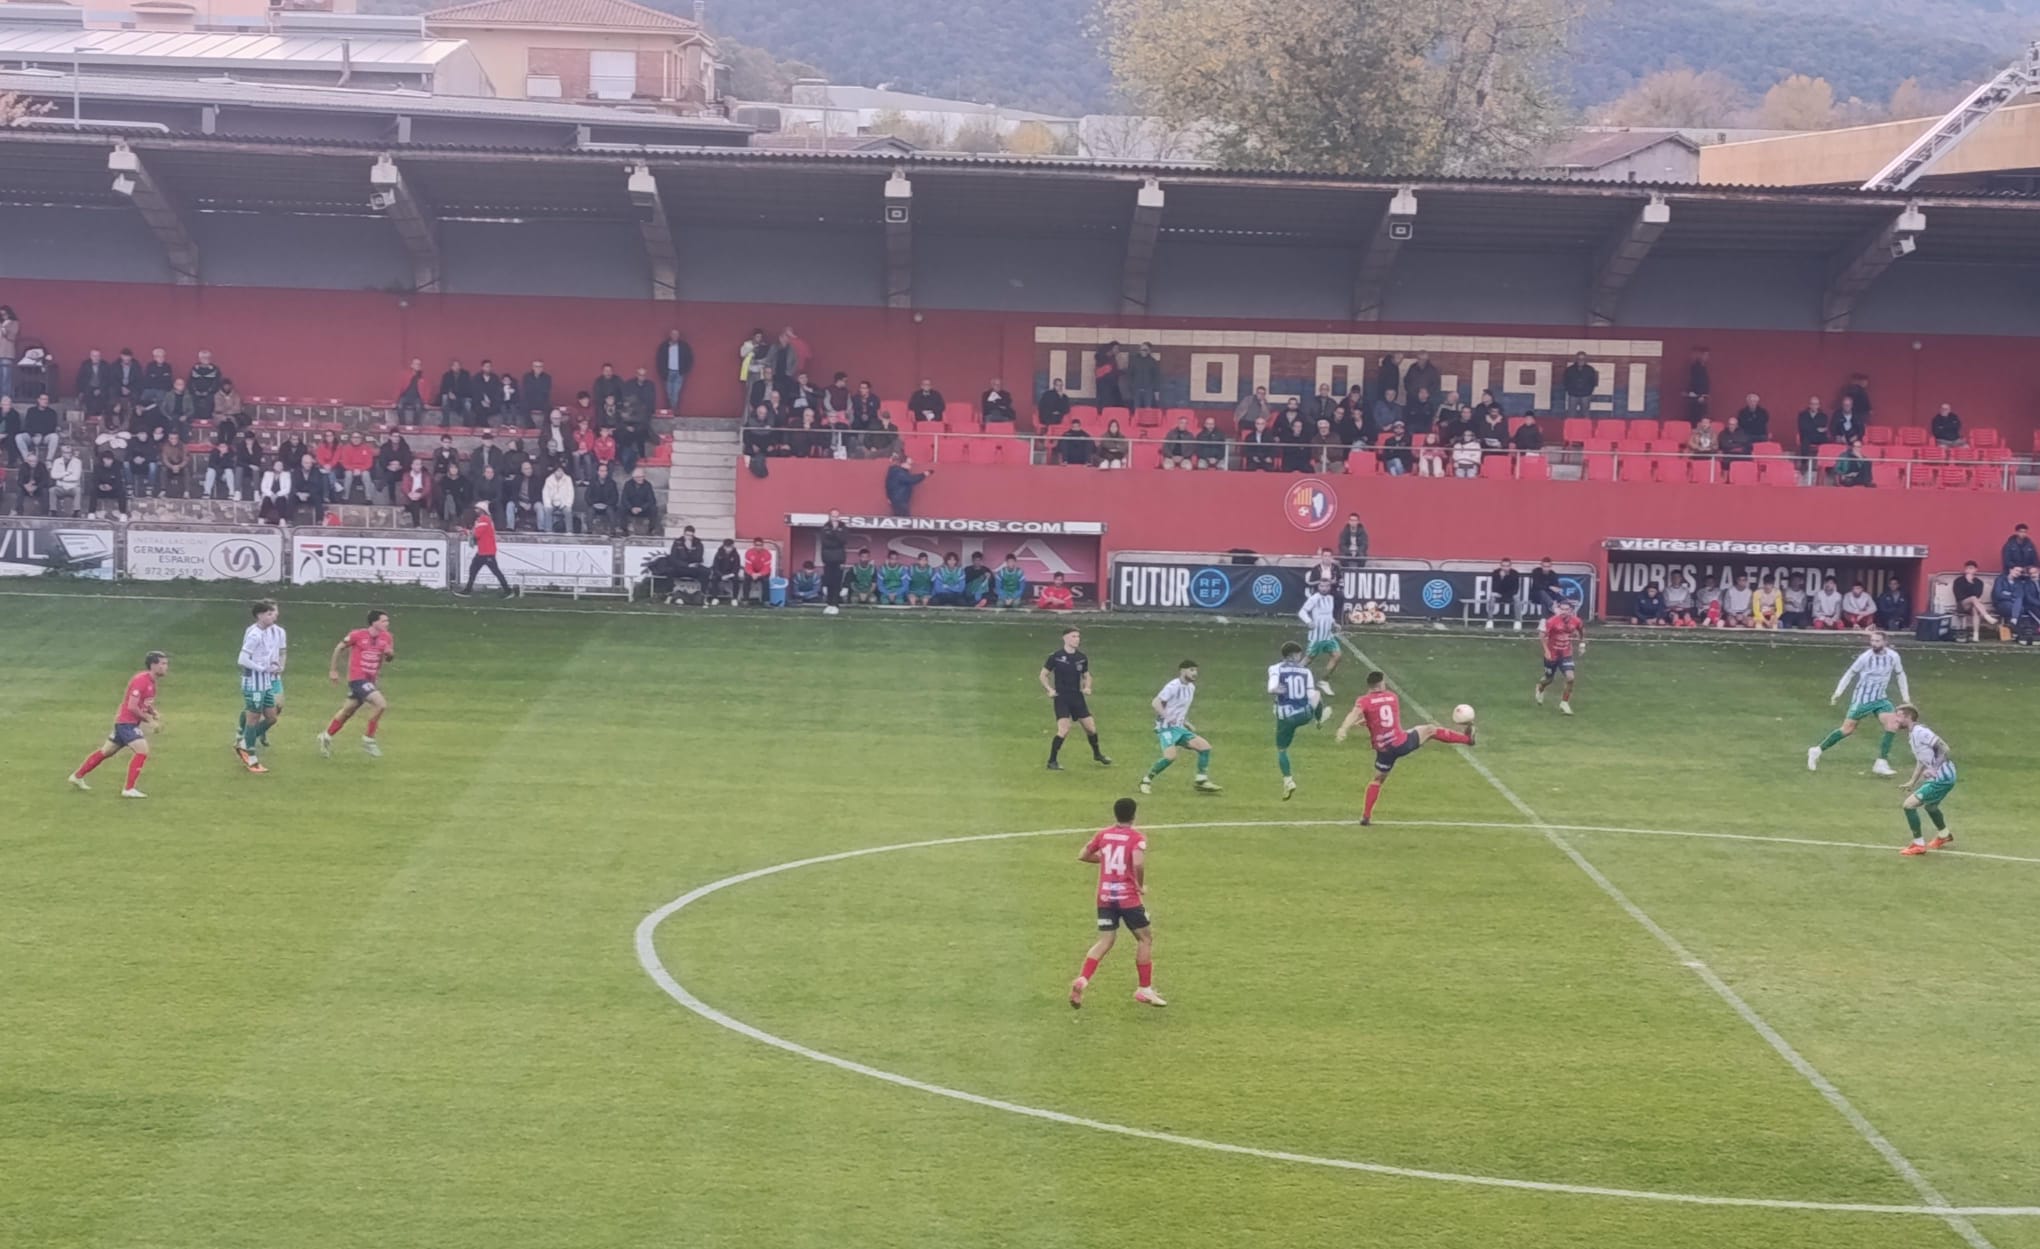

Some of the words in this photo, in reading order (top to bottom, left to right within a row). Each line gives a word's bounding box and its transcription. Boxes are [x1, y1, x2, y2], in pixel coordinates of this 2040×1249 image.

[133, 546, 185, 554] GERMANS
[159, 555, 205, 564] ESPARCH
[326, 544, 440, 567] SERTTEC
[1121, 566, 1190, 606] FUTUR
[1285, 675, 1306, 700] 10
[1379, 705, 1394, 727] 9
[1102, 843, 1127, 875] 14
